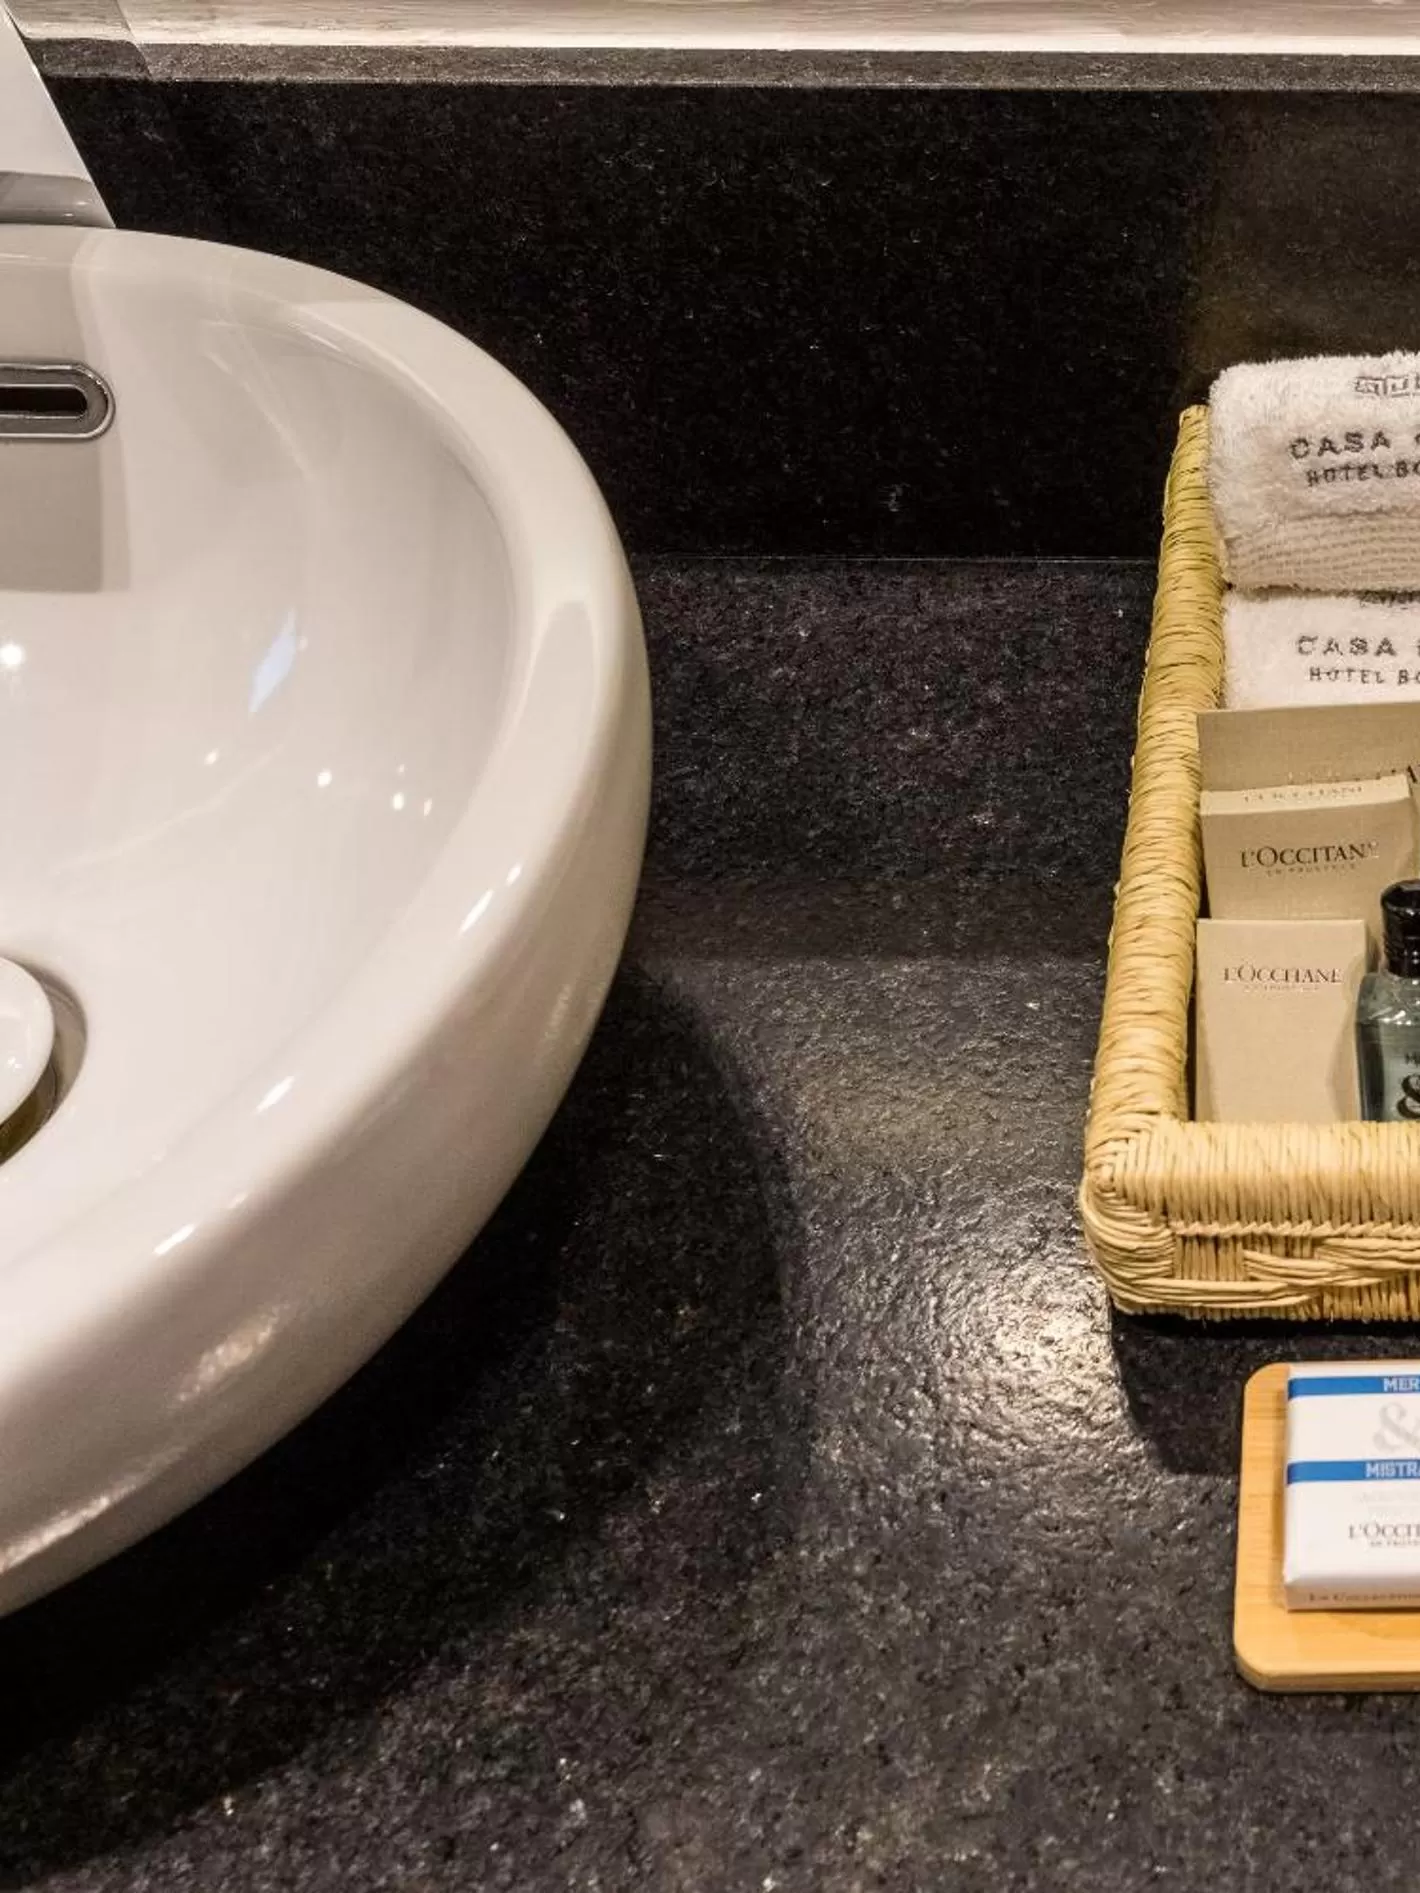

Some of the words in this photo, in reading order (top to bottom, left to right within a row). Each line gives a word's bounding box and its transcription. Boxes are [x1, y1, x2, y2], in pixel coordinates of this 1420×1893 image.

[1289, 430, 1391, 459] CASA
[1306, 463, 1386, 487] HOTEL
[1296, 635, 1398, 657] CASA
[1309, 666, 1386, 684] HOTEL
